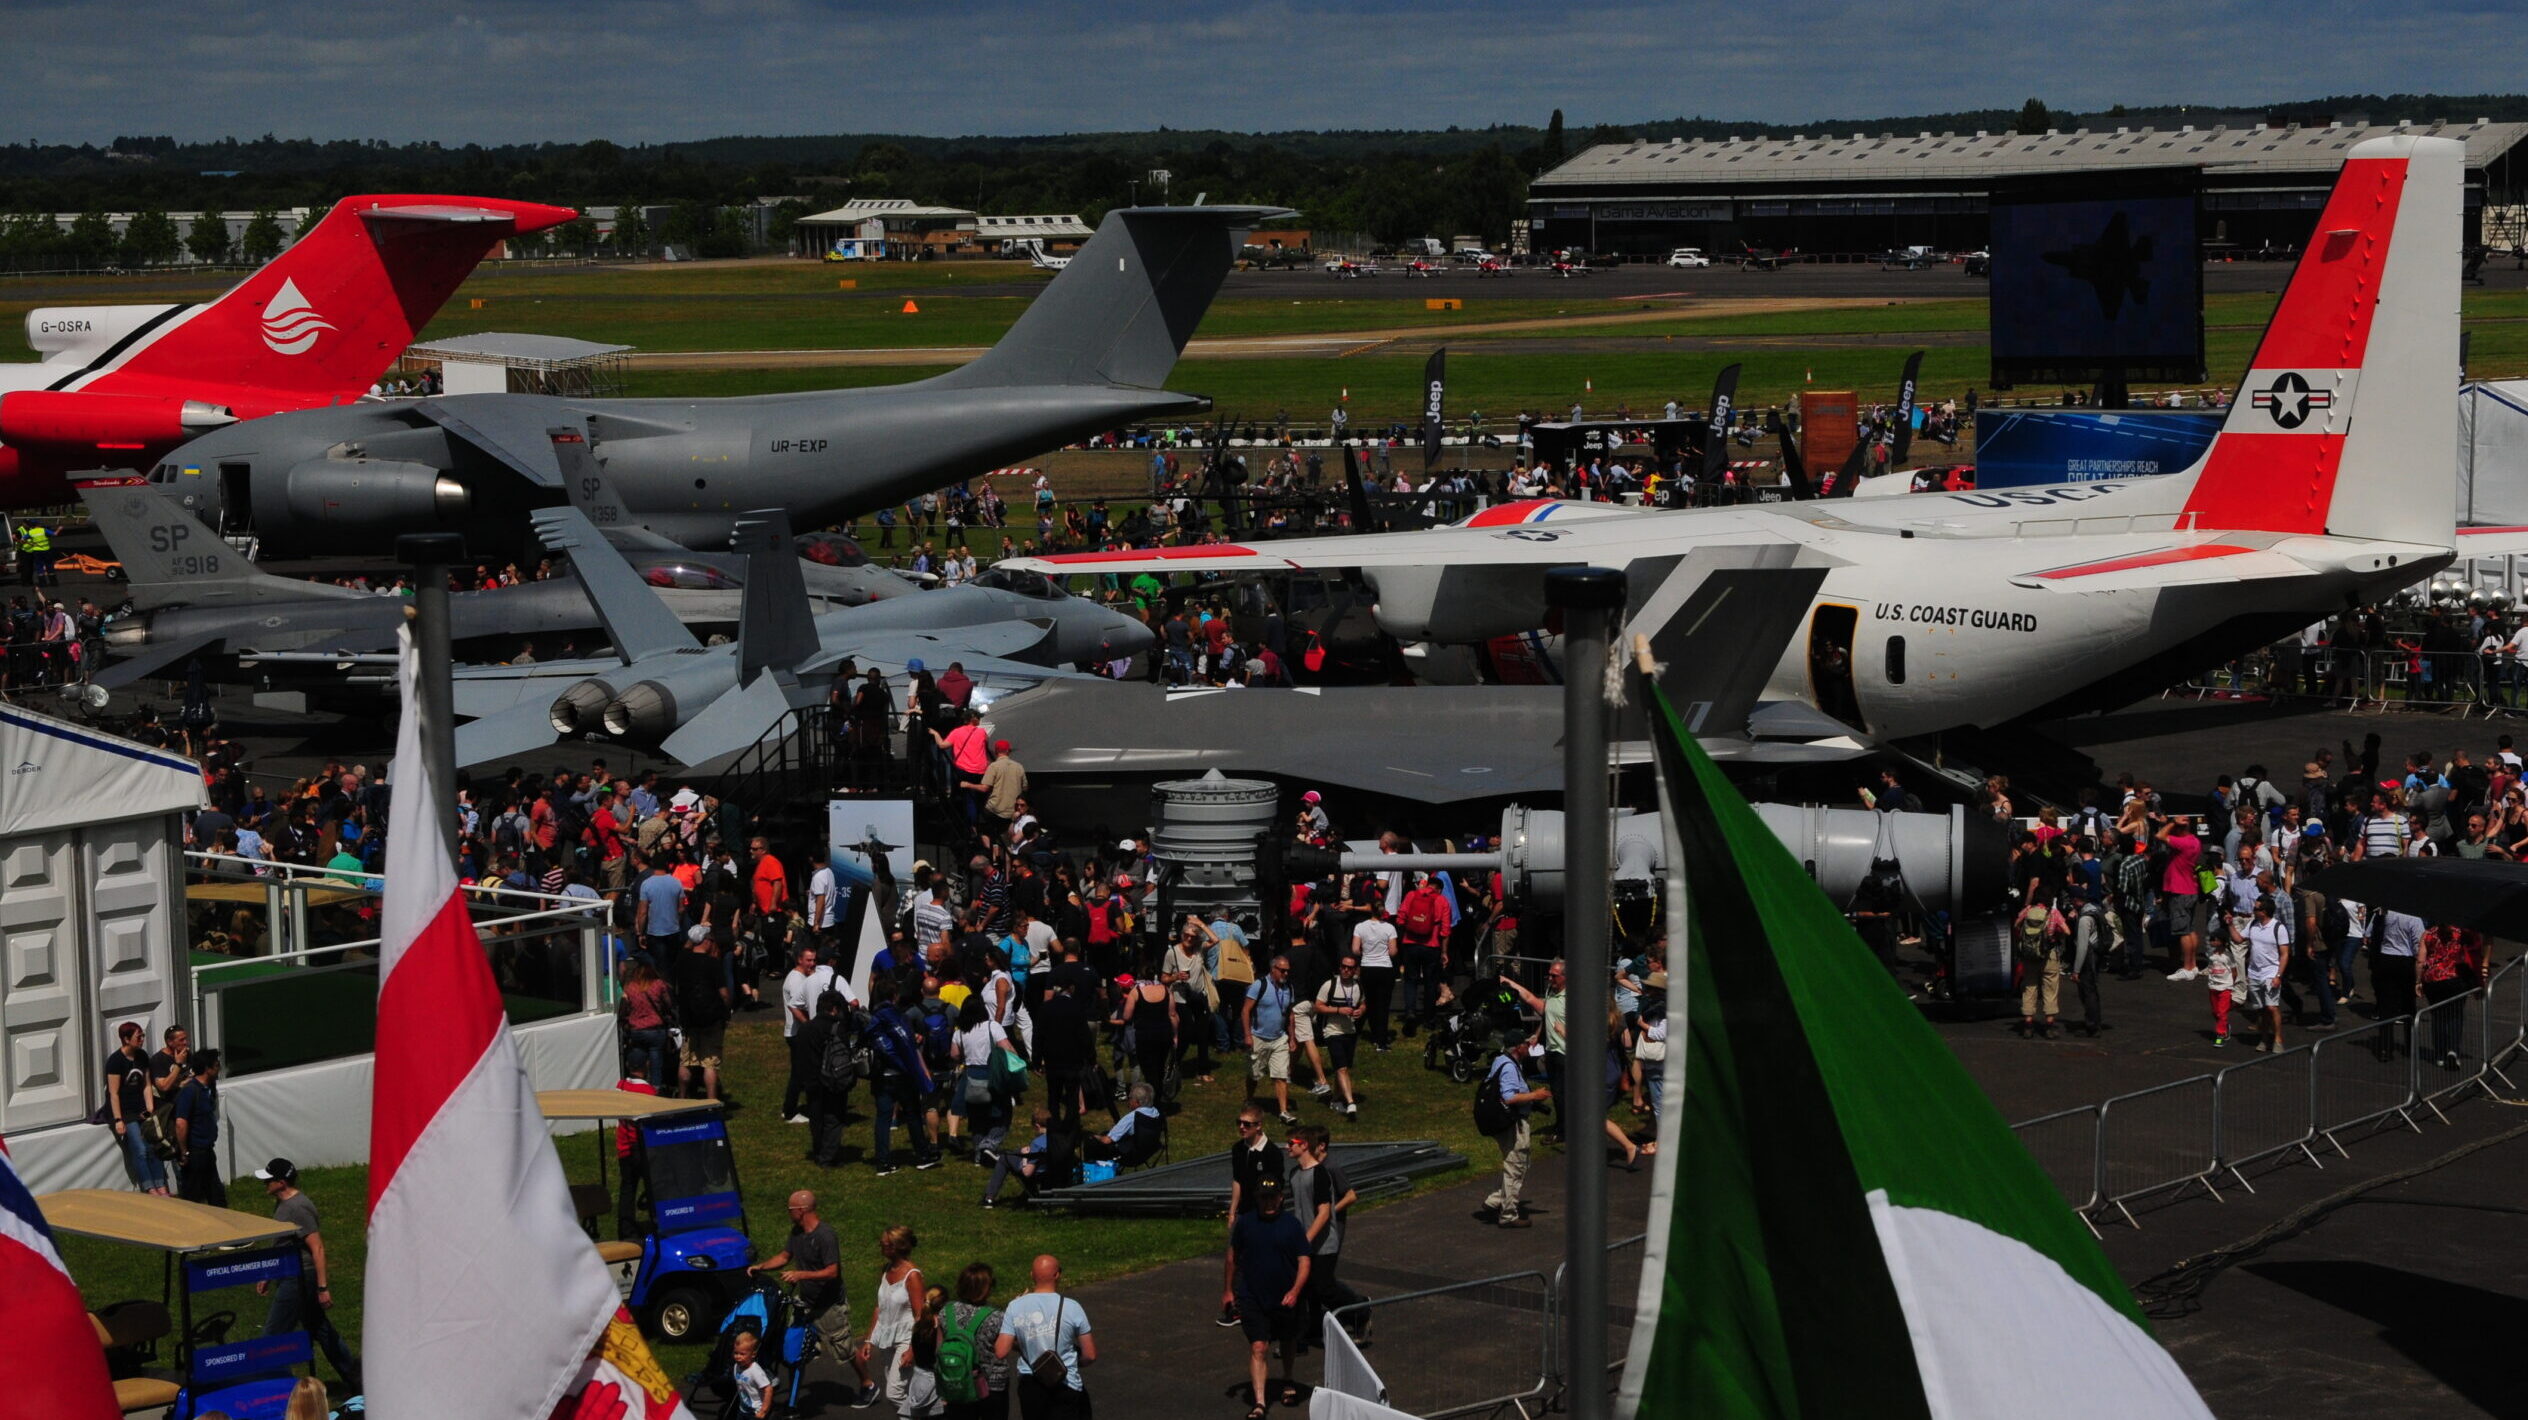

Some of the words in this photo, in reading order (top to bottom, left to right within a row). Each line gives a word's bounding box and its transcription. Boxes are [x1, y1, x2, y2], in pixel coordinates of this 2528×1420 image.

[1600, 205, 1643, 218] Gama
[1647, 203, 1710, 218] Aviation
[41, 321, 92, 333] G-OSRA
[1426, 380, 1443, 424] Jeep
[1901, 379, 1915, 422] Jeep
[1709, 394, 1731, 438] Jeep
[771, 440, 828, 453] UR-EXP
[1583, 441, 1603, 450] Jeep
[2067, 459, 2087, 471] GREAT
[2088, 459, 2136, 473] PARTNERSHIPS
[2137, 460, 2159, 473] REACH
[582, 478, 600, 501] SP
[1759, 489, 1782, 502] Jeep
[598, 506, 618, 522] 358
[150, 524, 190, 553] SP
[184, 555, 219, 575] 918
[1875, 603, 1905, 621] U.S.
[1910, 605, 1968, 626] COAST
[1971, 609, 2037, 632] GUARD
[206, 1266, 231, 1277] OFFICIAL
[230, 1260, 262, 1273] ORGANISER
[261, 1258, 280, 1269] BUGGY
[204, 1354, 238, 1367] SPONSORED
